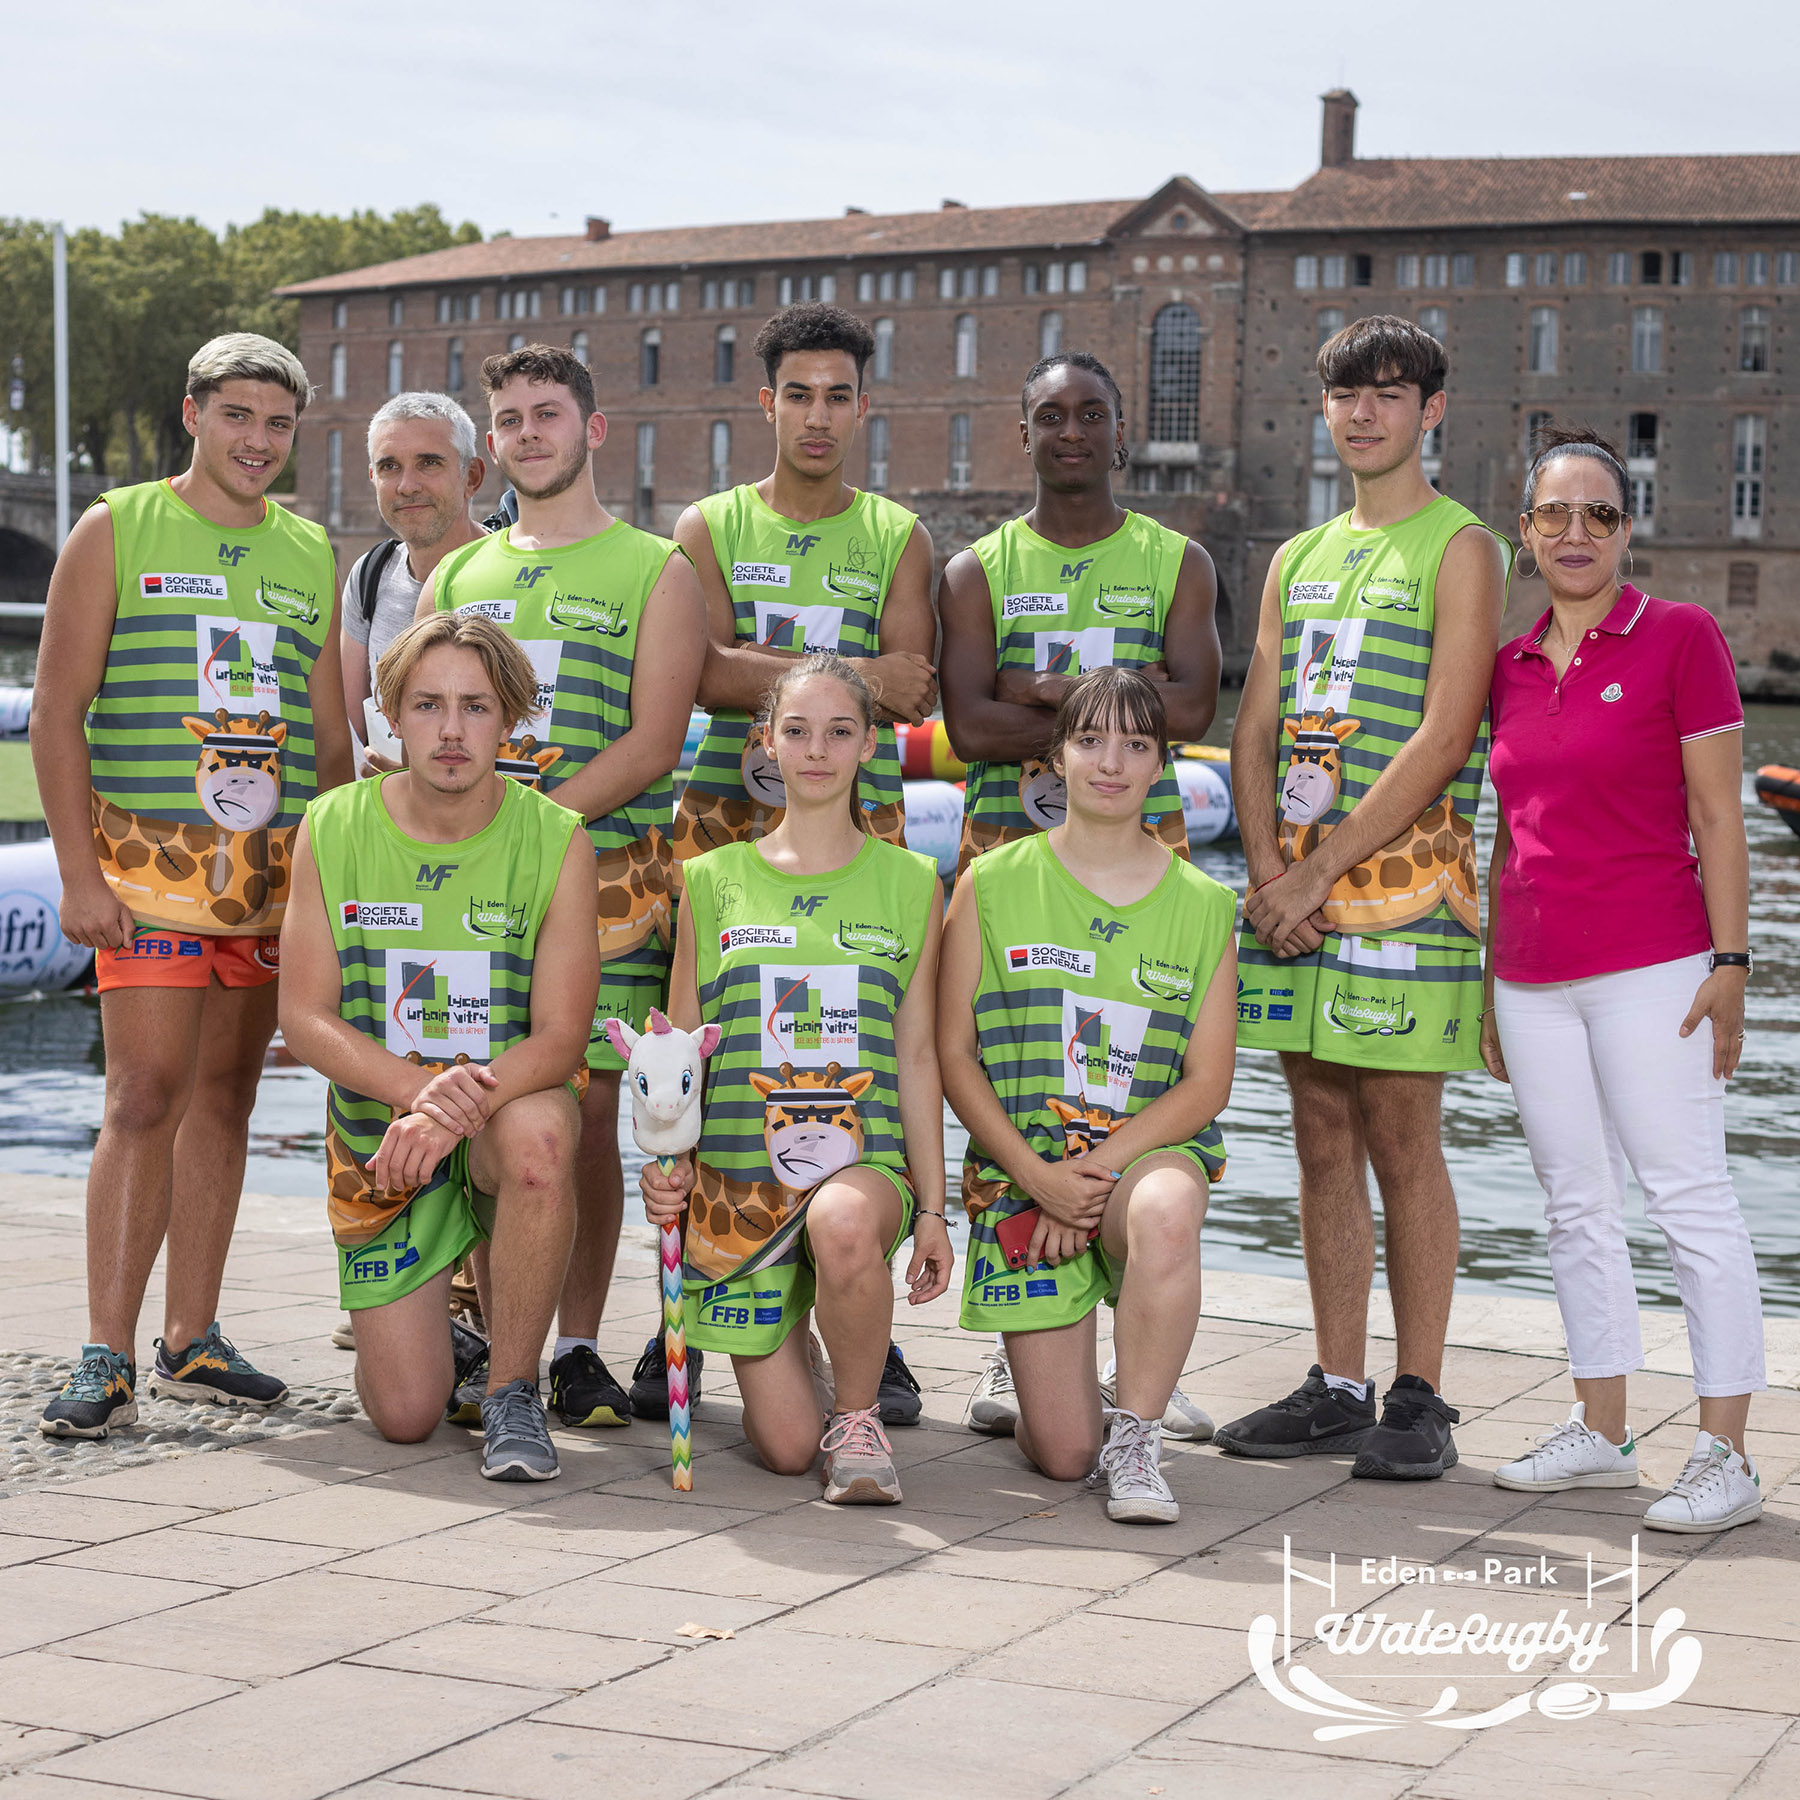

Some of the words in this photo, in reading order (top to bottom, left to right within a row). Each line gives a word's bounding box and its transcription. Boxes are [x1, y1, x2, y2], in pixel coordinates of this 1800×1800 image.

[786, 534, 822, 557] MF
[218, 543, 250, 567] MF
[515, 566, 553, 588] MF
[1060, 558, 1094, 581] MF
[165, 576, 212, 586] SOCIETE
[1293, 584, 1329, 593] SOCIETE
[165, 585, 224, 596] GENERALE
[1292, 592, 1334, 601] GENERALE
[460, 603, 502, 615] SOCIETE
[590, 597, 606, 607] Park
[1007, 596, 1053, 607] SOCIETE
[1007, 603, 1064, 615] GENERALE
[416, 864, 459, 891] MF
[790, 895, 829, 917] MF
[360, 916, 418, 926] ENERALE
[0, 908, 45, 952] fri
[731, 928, 780, 938] SOCIETE
[1090, 917, 1129, 943] MF
[134, 939, 173, 955] FFB
[731, 935, 793, 946] GENERALE
[1031, 947, 1079, 963] SOCIETE
[1032, 956, 1091, 974] GENERALE
[596, 1003, 611, 1011] ark
[1370, 996, 1386, 1005] Park
[354, 1260, 389, 1279] FFB
[983, 1285, 1020, 1302] FFB
[711, 1305, 749, 1324] FFB
